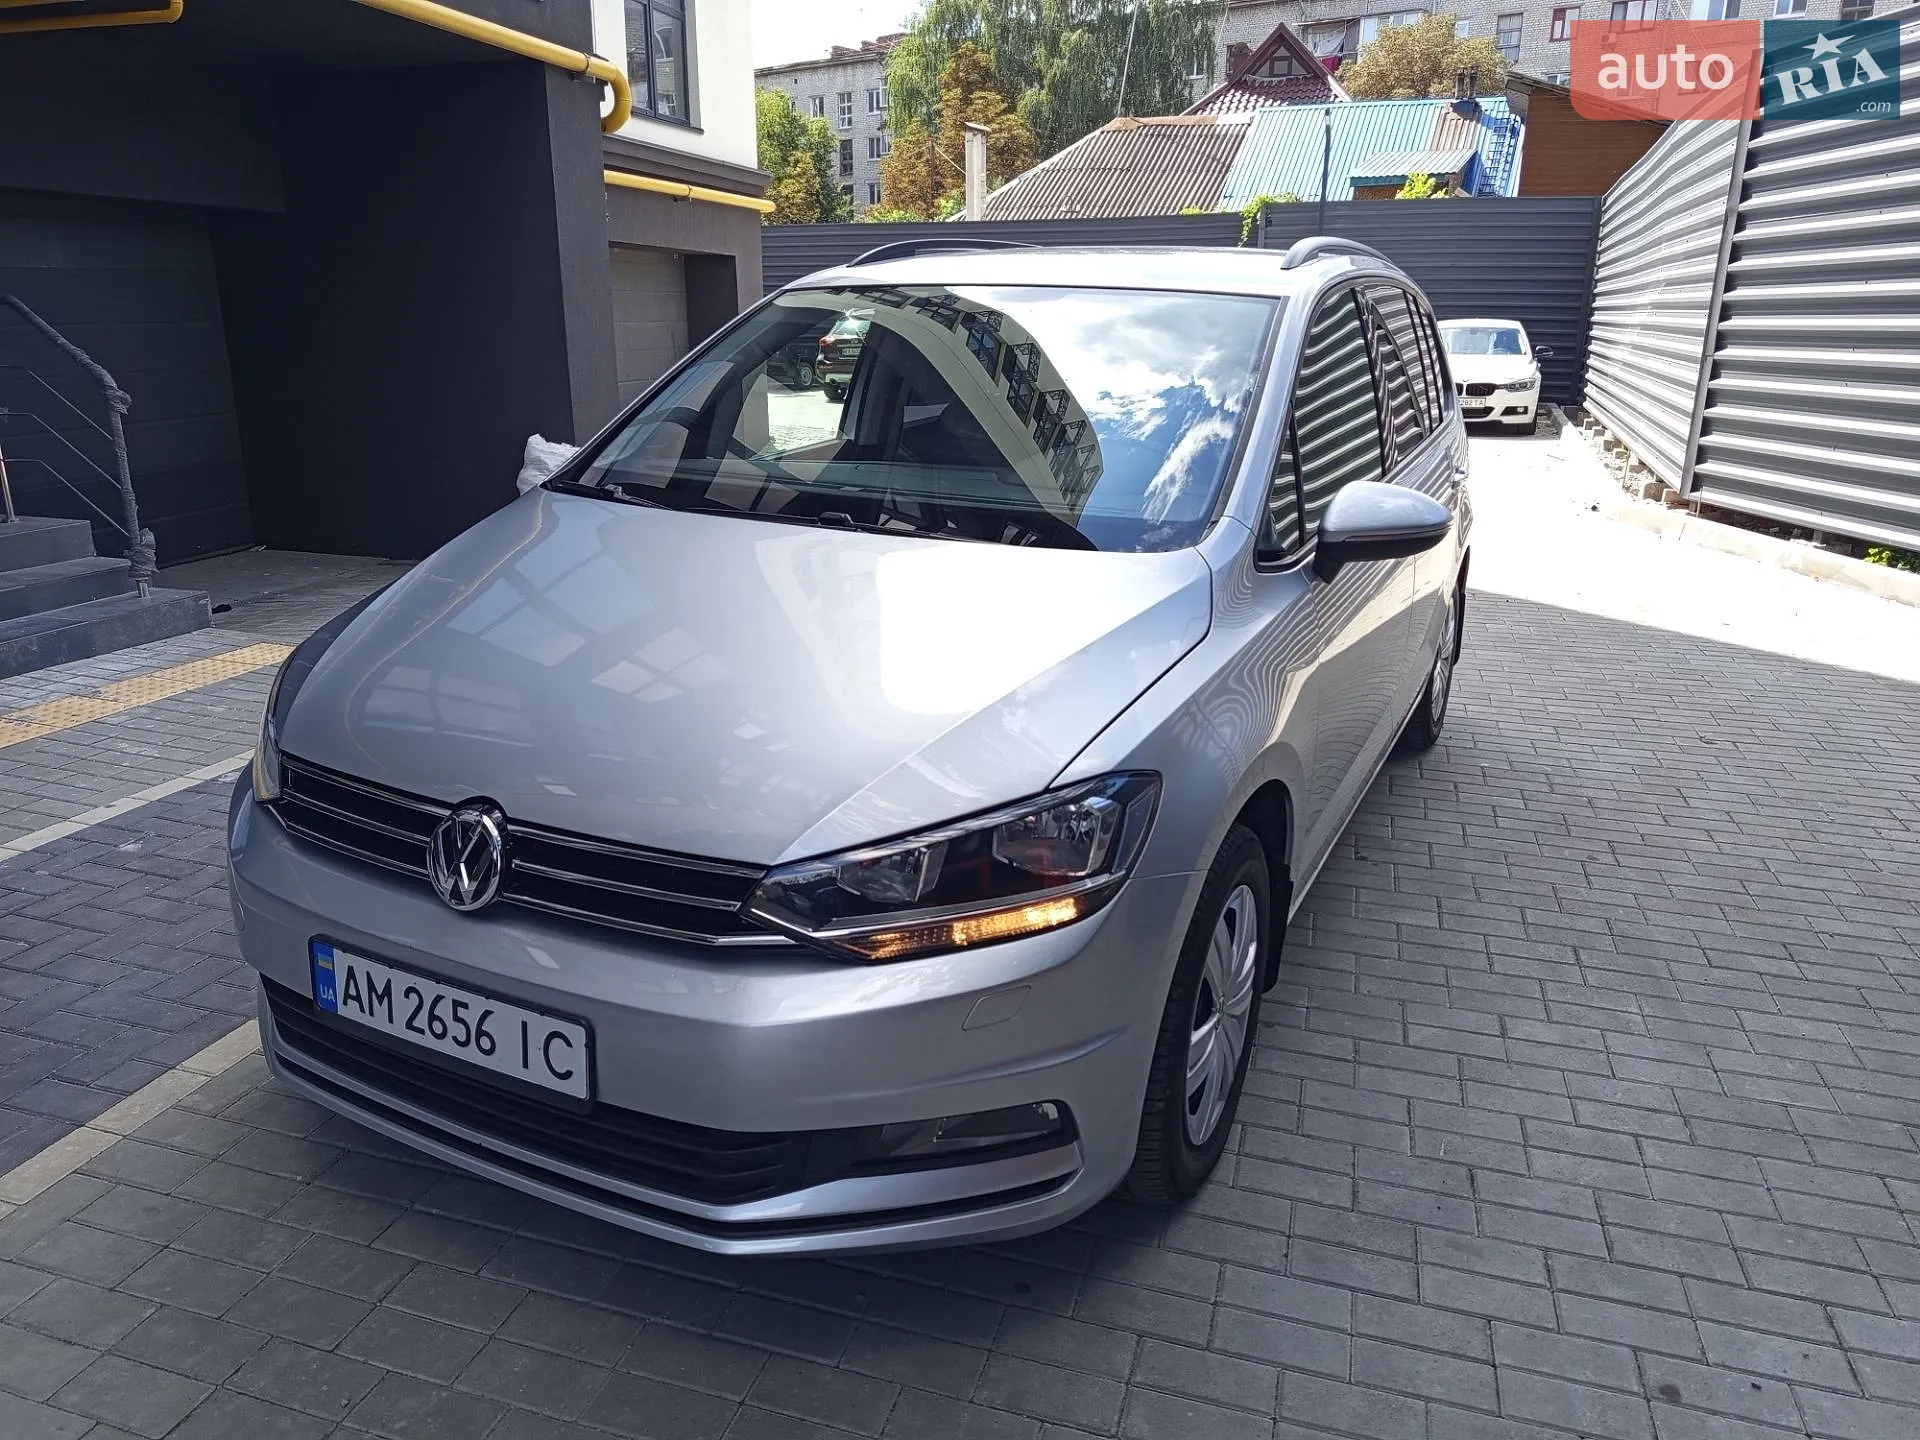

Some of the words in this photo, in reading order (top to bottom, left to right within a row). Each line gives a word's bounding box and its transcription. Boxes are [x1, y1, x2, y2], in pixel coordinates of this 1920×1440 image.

[320, 983, 336, 1003] UA
[342, 965, 394, 1025] AM
[403, 985, 497, 1056] 2656
[520, 1020, 574, 1081] IC
